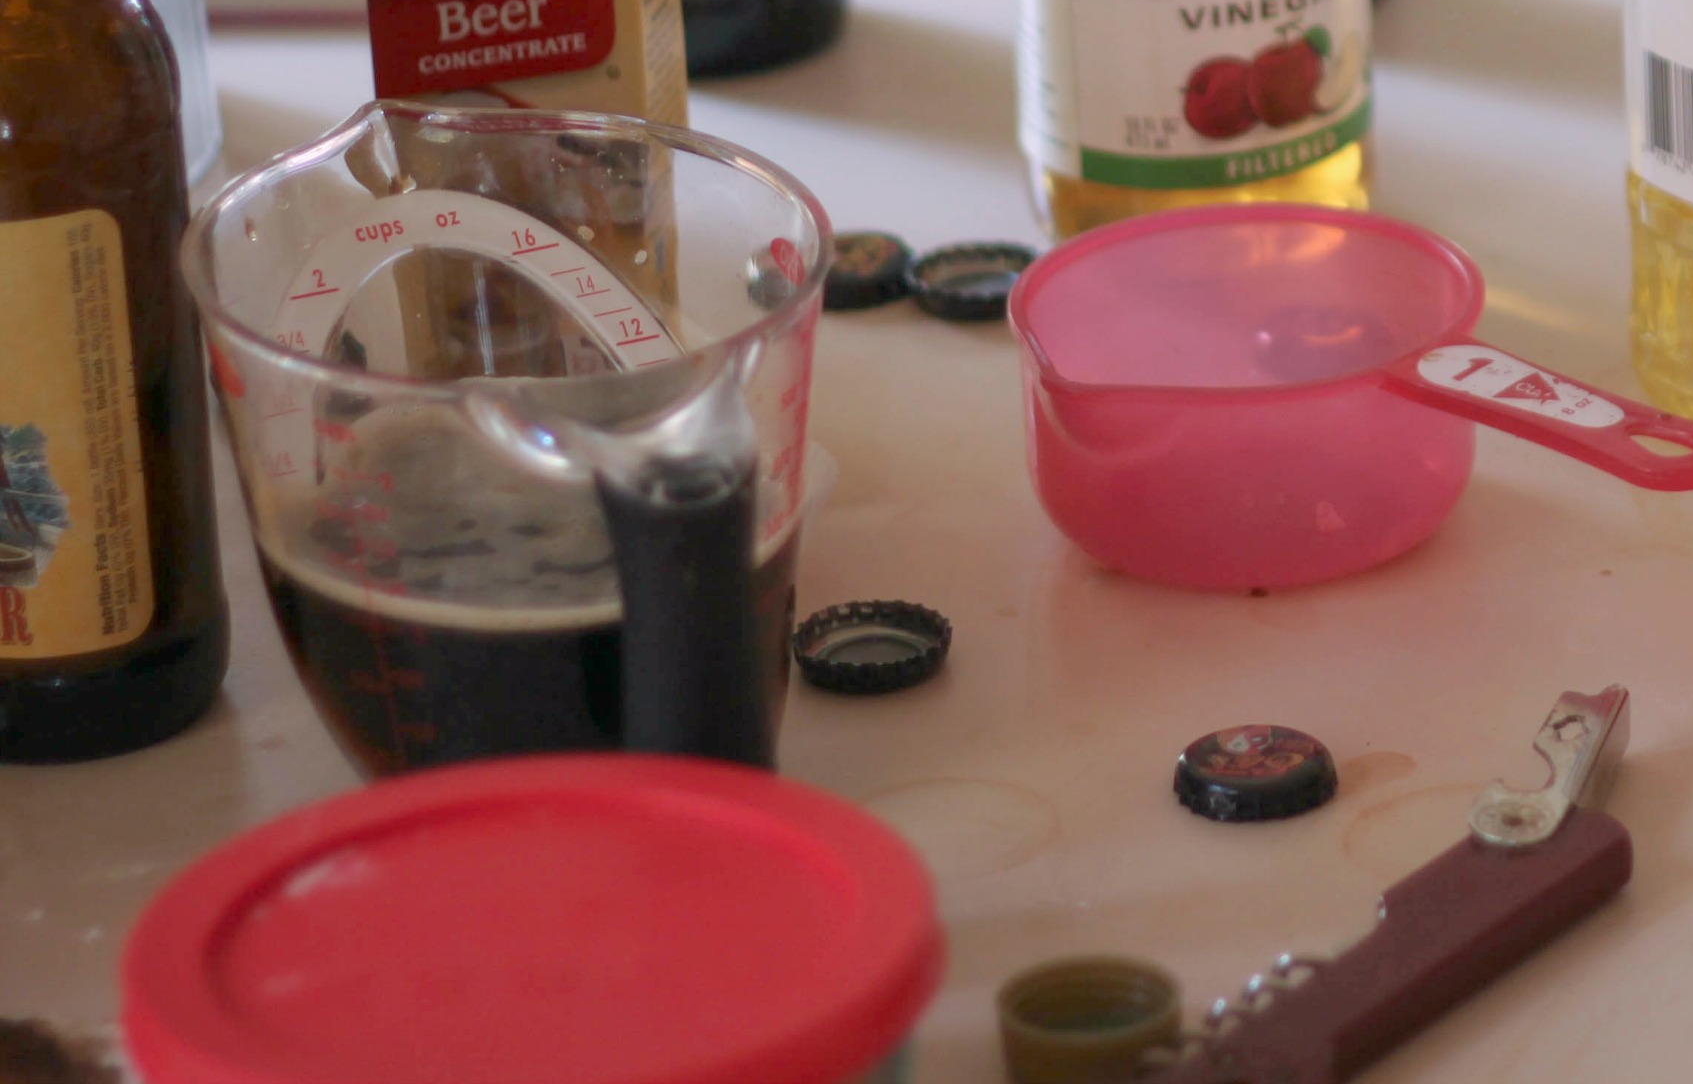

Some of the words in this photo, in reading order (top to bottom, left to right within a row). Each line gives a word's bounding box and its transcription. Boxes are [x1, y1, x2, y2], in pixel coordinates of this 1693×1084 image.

[418, 32, 587, 76] CONCENTRATE
[1225, 132, 1337, 179] FILTERED
[355, 219, 405, 243] cups
[435, 211, 461, 229] oz
[512, 228, 536, 248] 16
[313, 269, 326, 289] 2
[577, 276, 597, 293] 14
[619, 318, 644, 338] 12
[1452, 357, 1494, 382] 1
